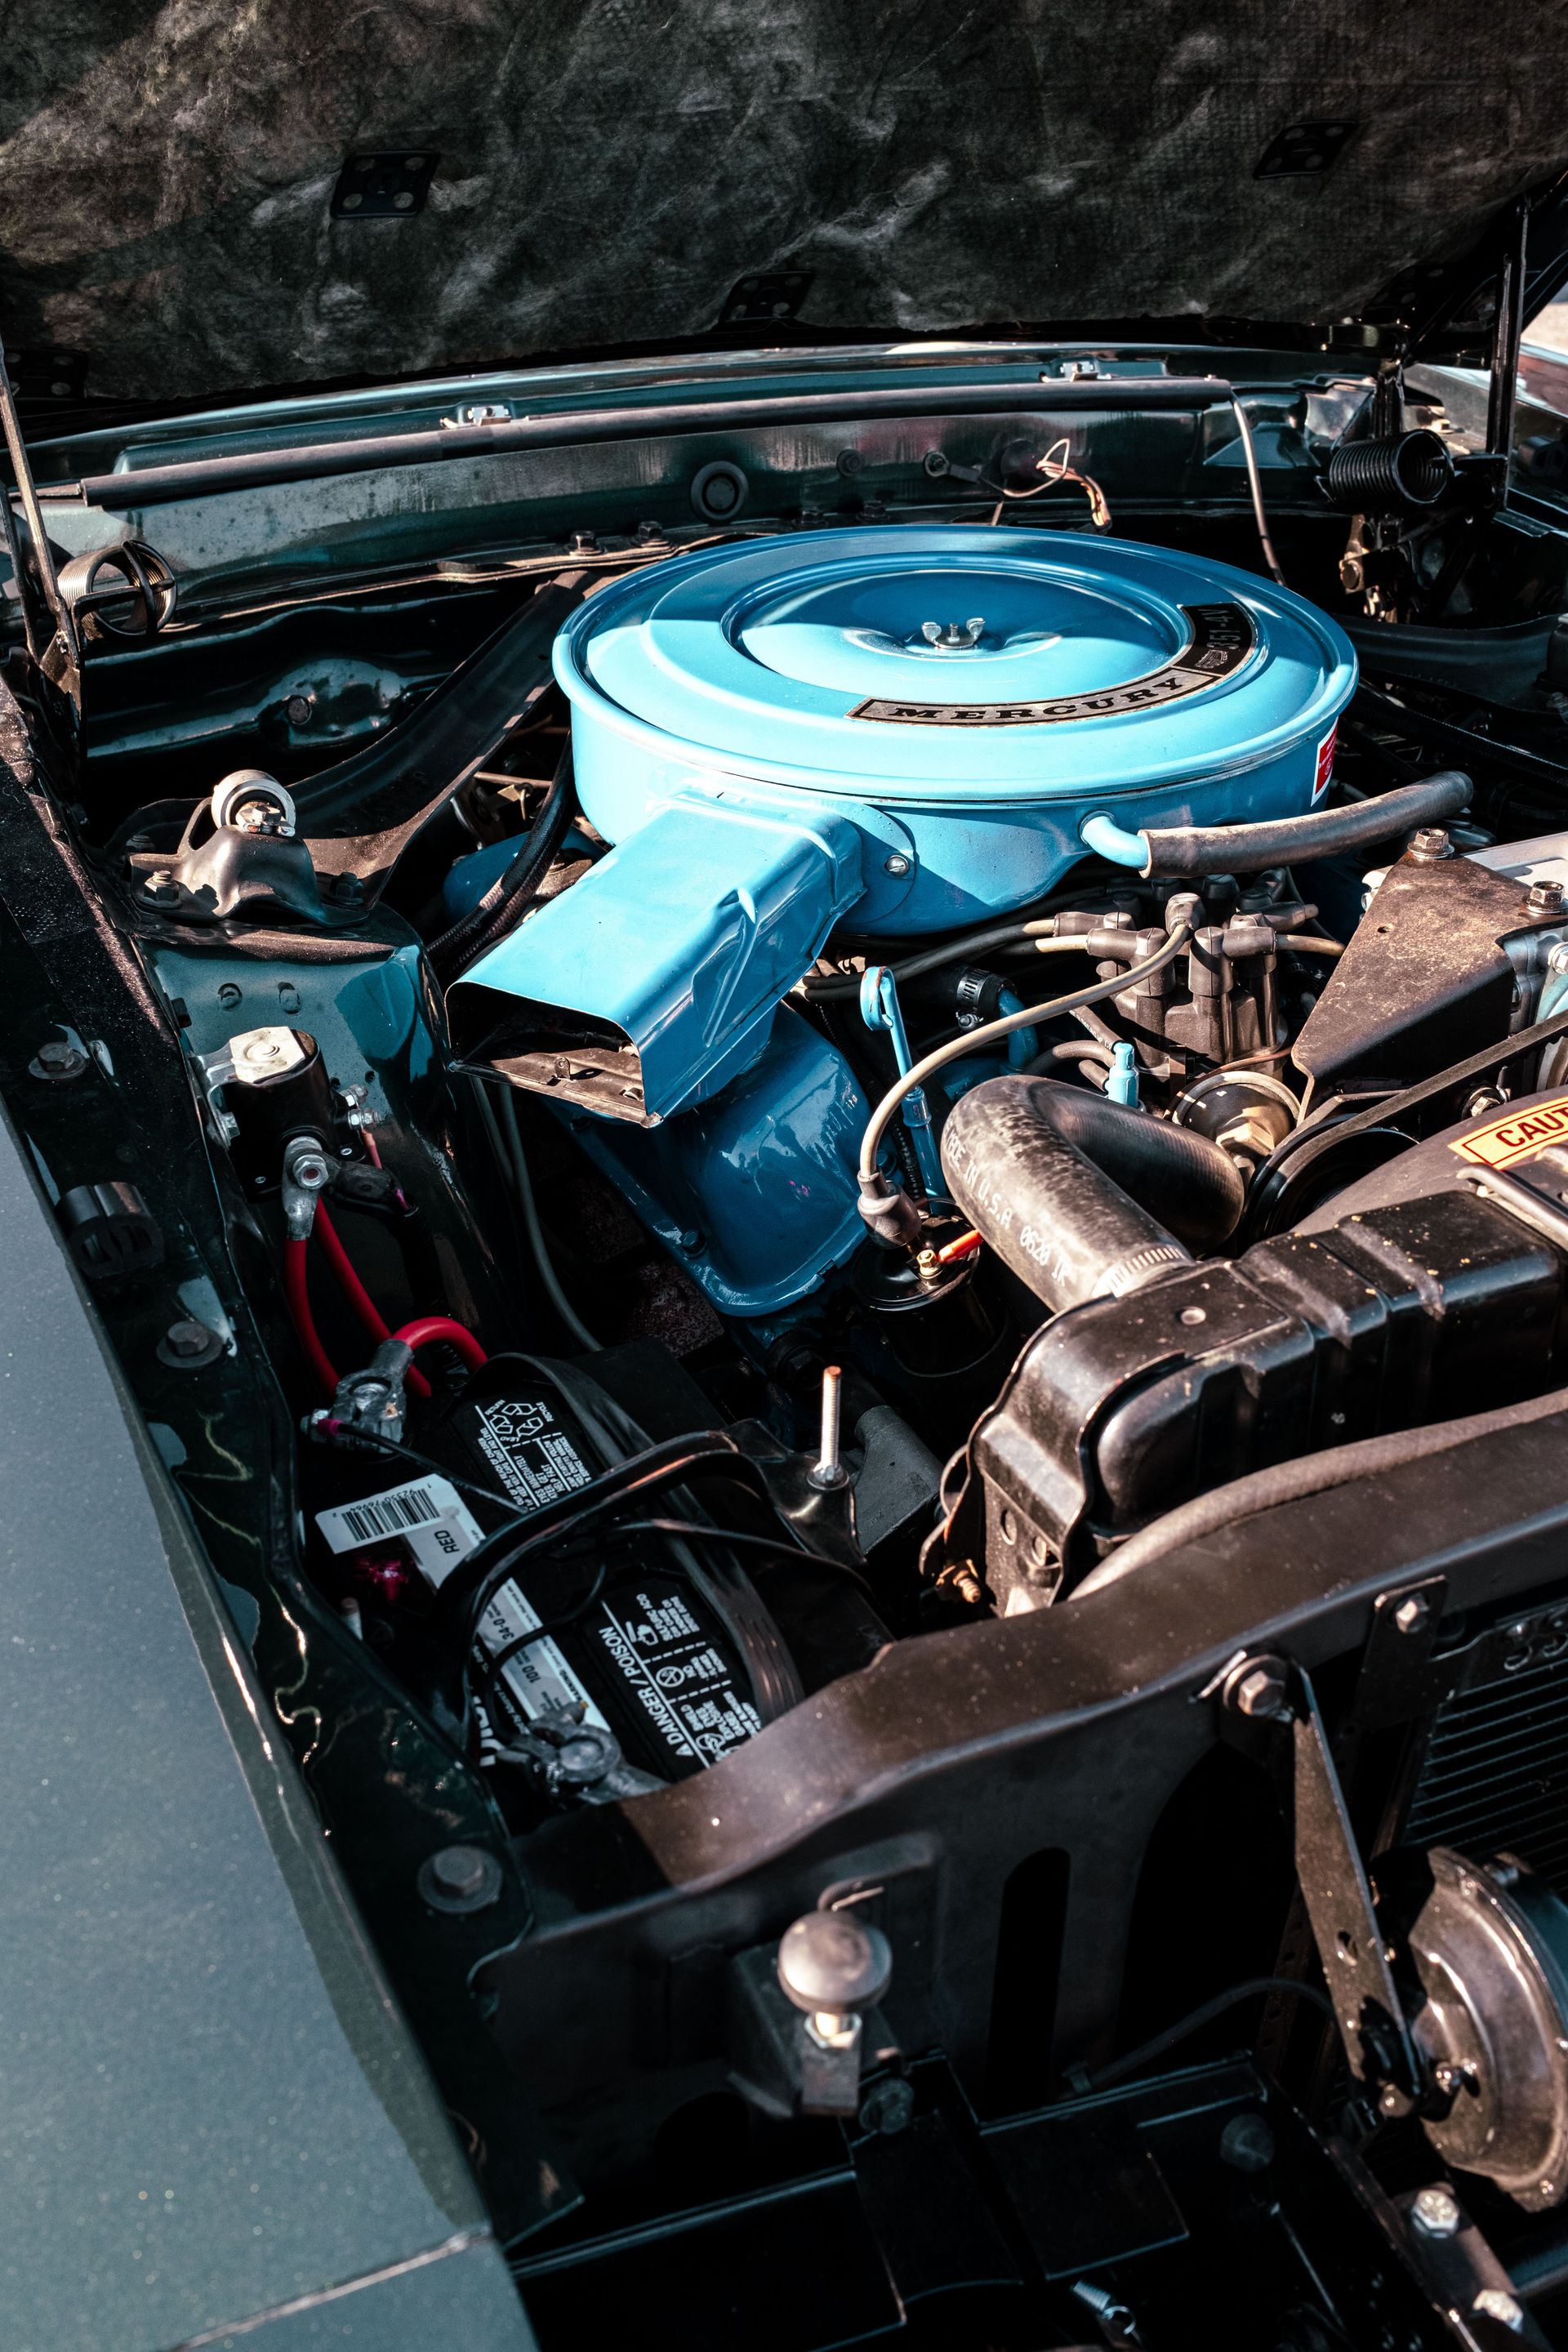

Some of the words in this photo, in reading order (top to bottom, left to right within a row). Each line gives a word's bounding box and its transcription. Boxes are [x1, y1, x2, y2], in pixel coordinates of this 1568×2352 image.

[1199, 608, 1241, 650] 351-4V
[889, 676, 1187, 720] MERCURY
[536, 1401, 554, 1422] RECYCLE
[480, 1428, 492, 1440] LEVEL
[478, 1437, 494, 1459] CHILDREN
[488, 1440, 498, 1450] AND
[544, 1441, 558, 1457] FOLLOW
[493, 1450, 506, 1463] TIGHT
[494, 1464, 508, 1480] REACH
[501, 1463, 513, 1474] CAPS
[514, 1454, 541, 1489] IMMEDIATELY
[541, 1464, 556, 1478] FAST
[554, 1458, 571, 1477] STARTING
[574, 1460, 590, 1477] SERVICE
[509, 1475, 521, 1486] VENT
[536, 1472, 549, 1484] GET
[550, 1478, 566, 1491] HELP
[513, 1496, 525, 1506] OUT
[516, 1486, 528, 1497] KEEP
[535, 1489, 550, 1503] EYES
[544, 1484, 558, 1499] ATER
[434, 1530, 461, 1555] RED
[636, 1593, 653, 1609] ACID
[646, 1609, 674, 1642] SULFURIC
[657, 1608, 674, 1627] CAUSE
[667, 1607, 691, 1636] BLINDNESS
[492, 1618, 514, 1641] 34-0
[599, 1626, 642, 1677] POISON
[521, 1664, 541, 1684] 100
[683, 1664, 697, 1678] NO
[637, 1686, 685, 1745] DANGER
[680, 1704, 704, 1731] SHIELD
[696, 1707, 715, 1728] EYES
[702, 1699, 735, 1740] EXPLOSIVE
[723, 1710, 746, 1737] GASES
